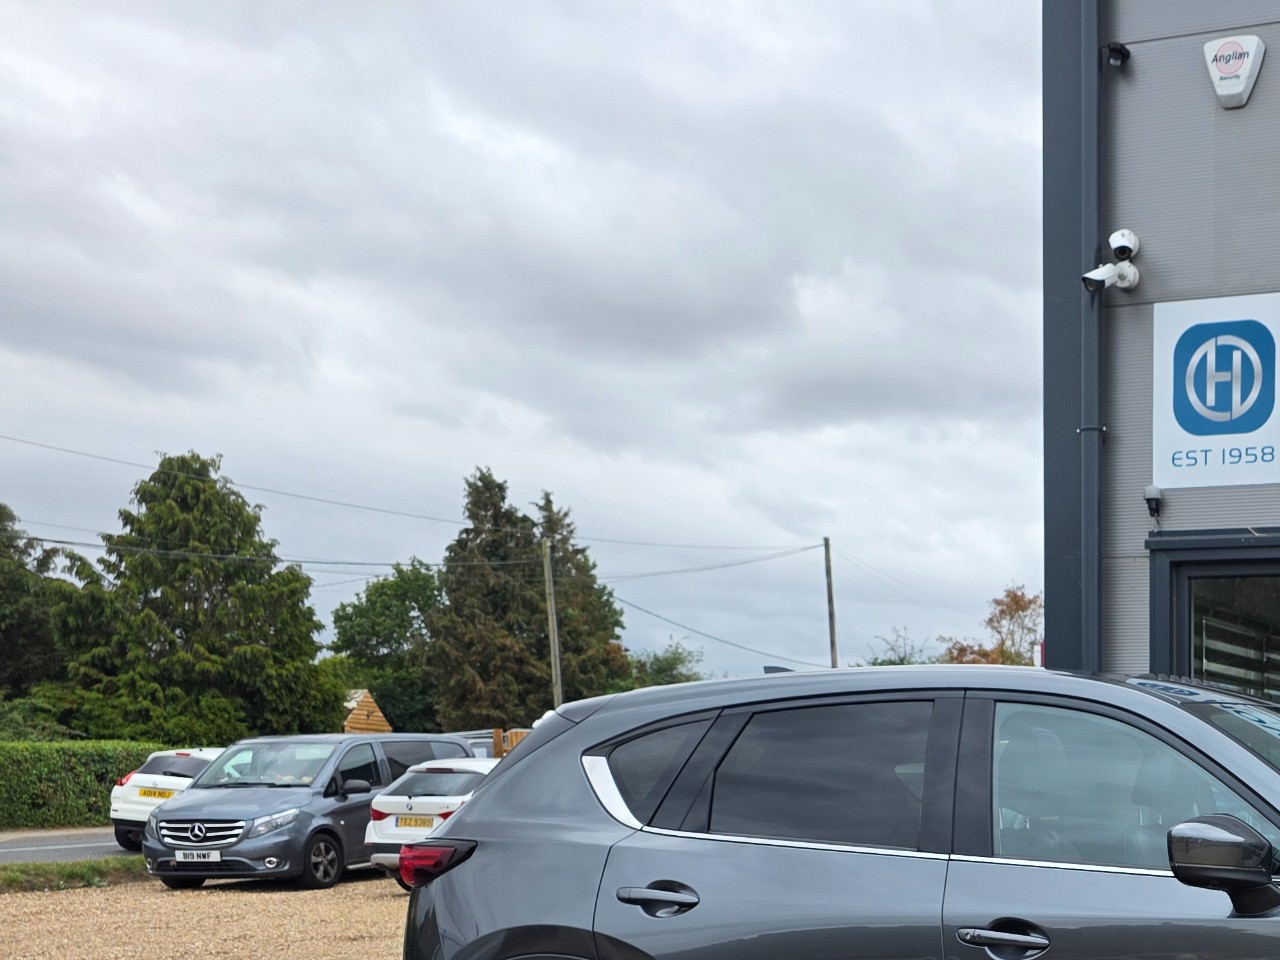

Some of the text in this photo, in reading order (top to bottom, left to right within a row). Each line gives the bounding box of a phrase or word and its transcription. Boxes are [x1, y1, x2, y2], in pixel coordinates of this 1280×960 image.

[1211, 51, 1250, 65] Anglian
[1171, 445, 1275, 468] EST 1958
